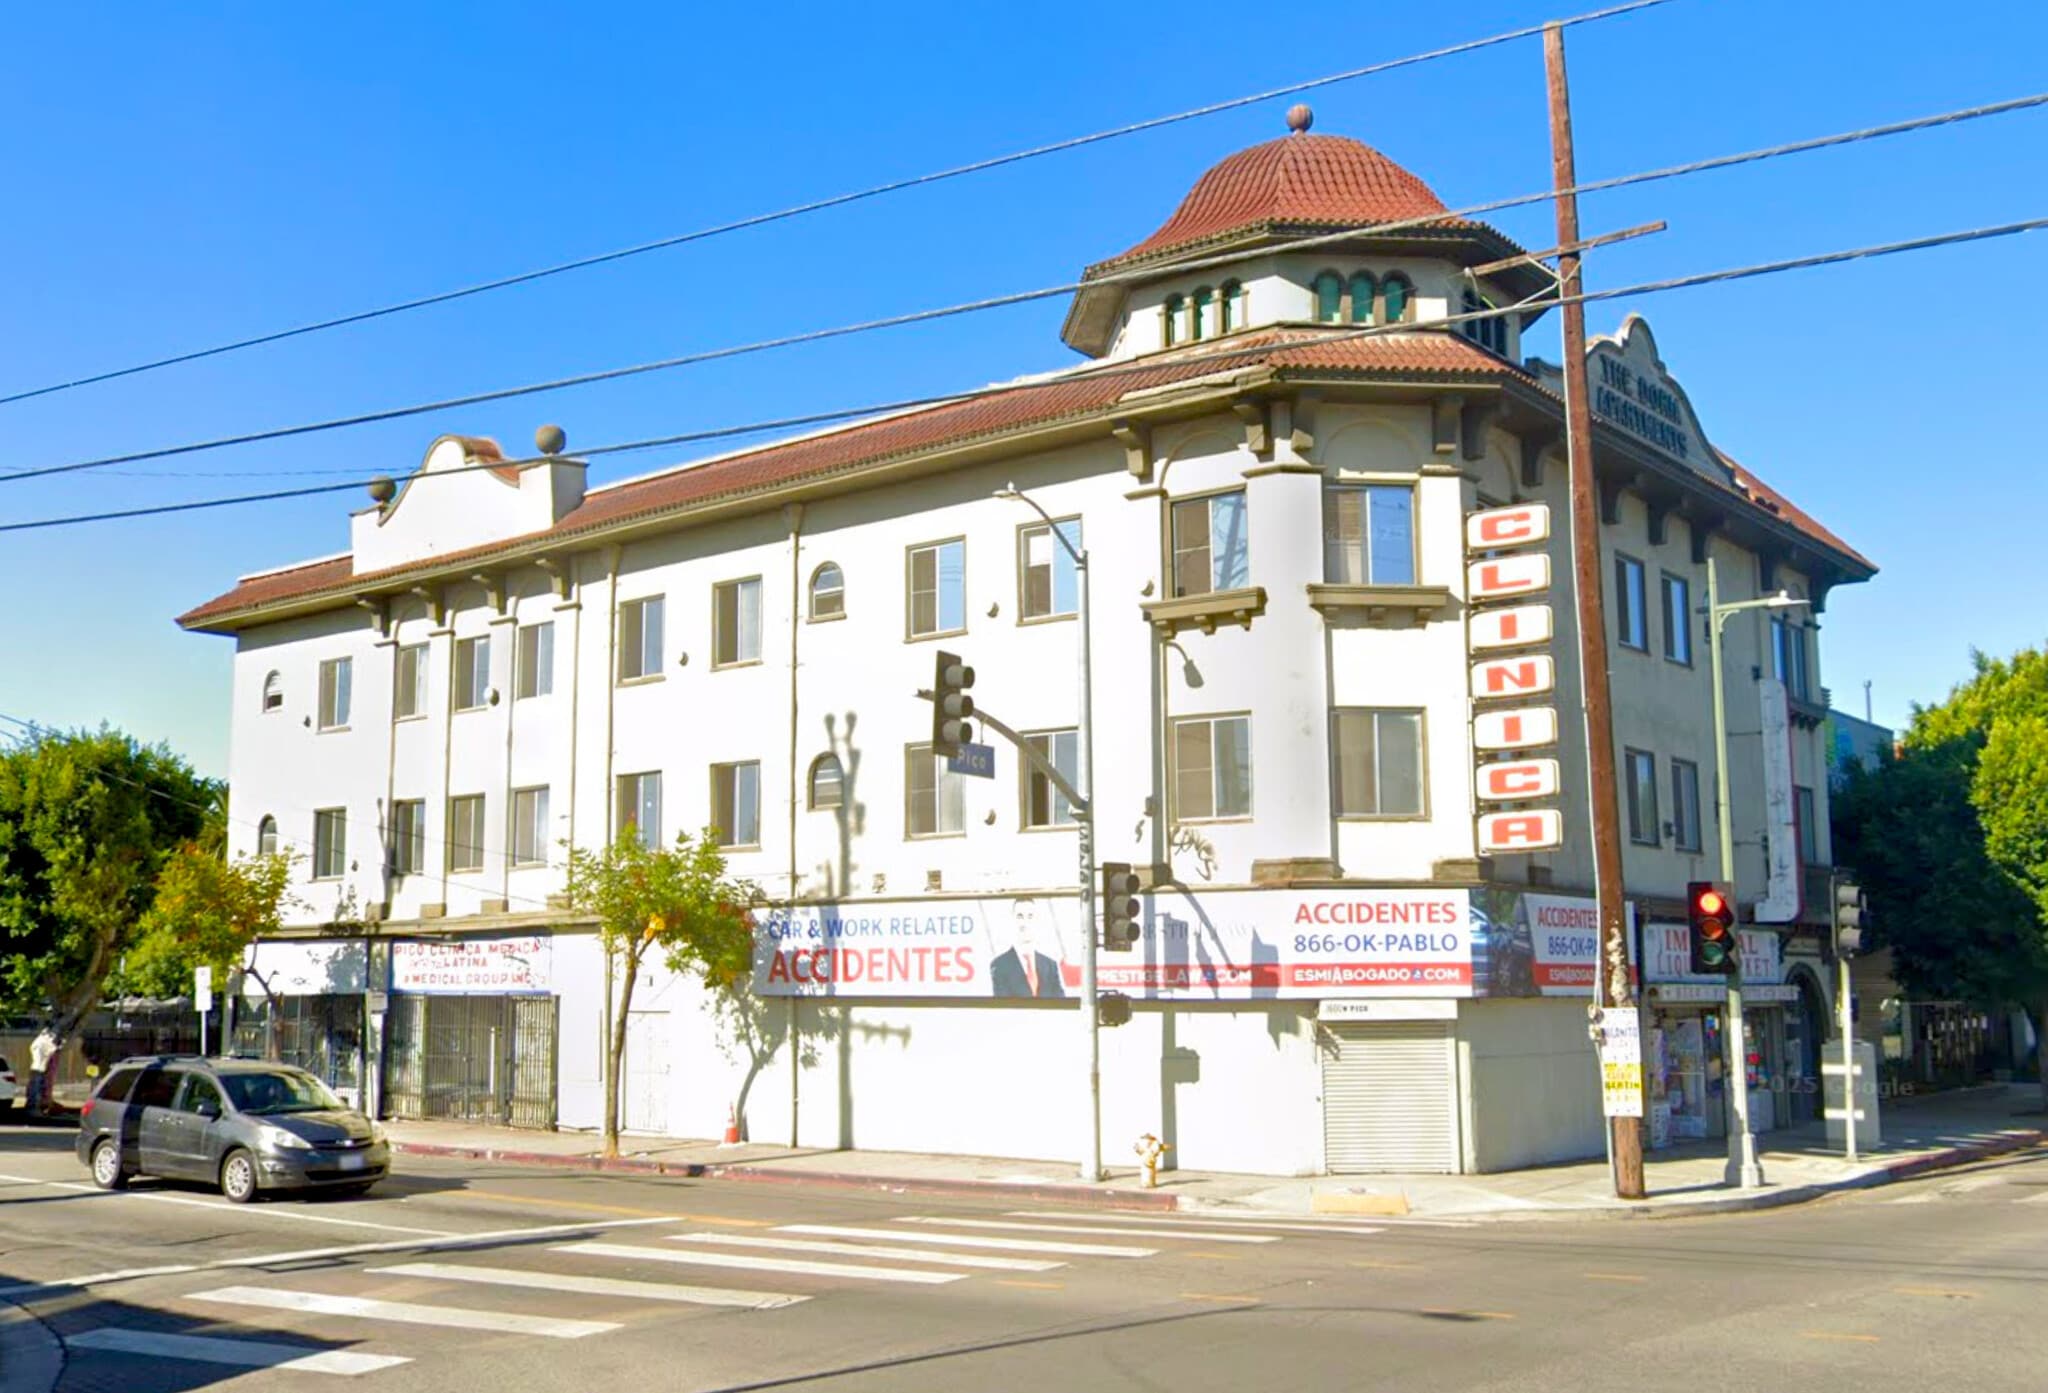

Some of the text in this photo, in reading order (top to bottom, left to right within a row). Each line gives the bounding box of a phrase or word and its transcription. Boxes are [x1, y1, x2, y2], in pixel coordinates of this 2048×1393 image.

[1481, 512, 1543, 844] CLINICA
[956, 748, 986, 769] Pico
[1294, 903, 1457, 924] ACCIDENTES
[768, 916, 974, 939] CAR & WORK RELATED
[394, 943, 424, 956] PICO
[430, 942, 481, 955] CLINICA
[1294, 934, 1458, 952] 866-OK-PABLO
[443, 956, 488, 967] LATINA
[768, 946, 975, 983] ACCIDENTES
[412, 973, 461, 985] MEDICAL
[466, 972, 506, 985] GROUP
